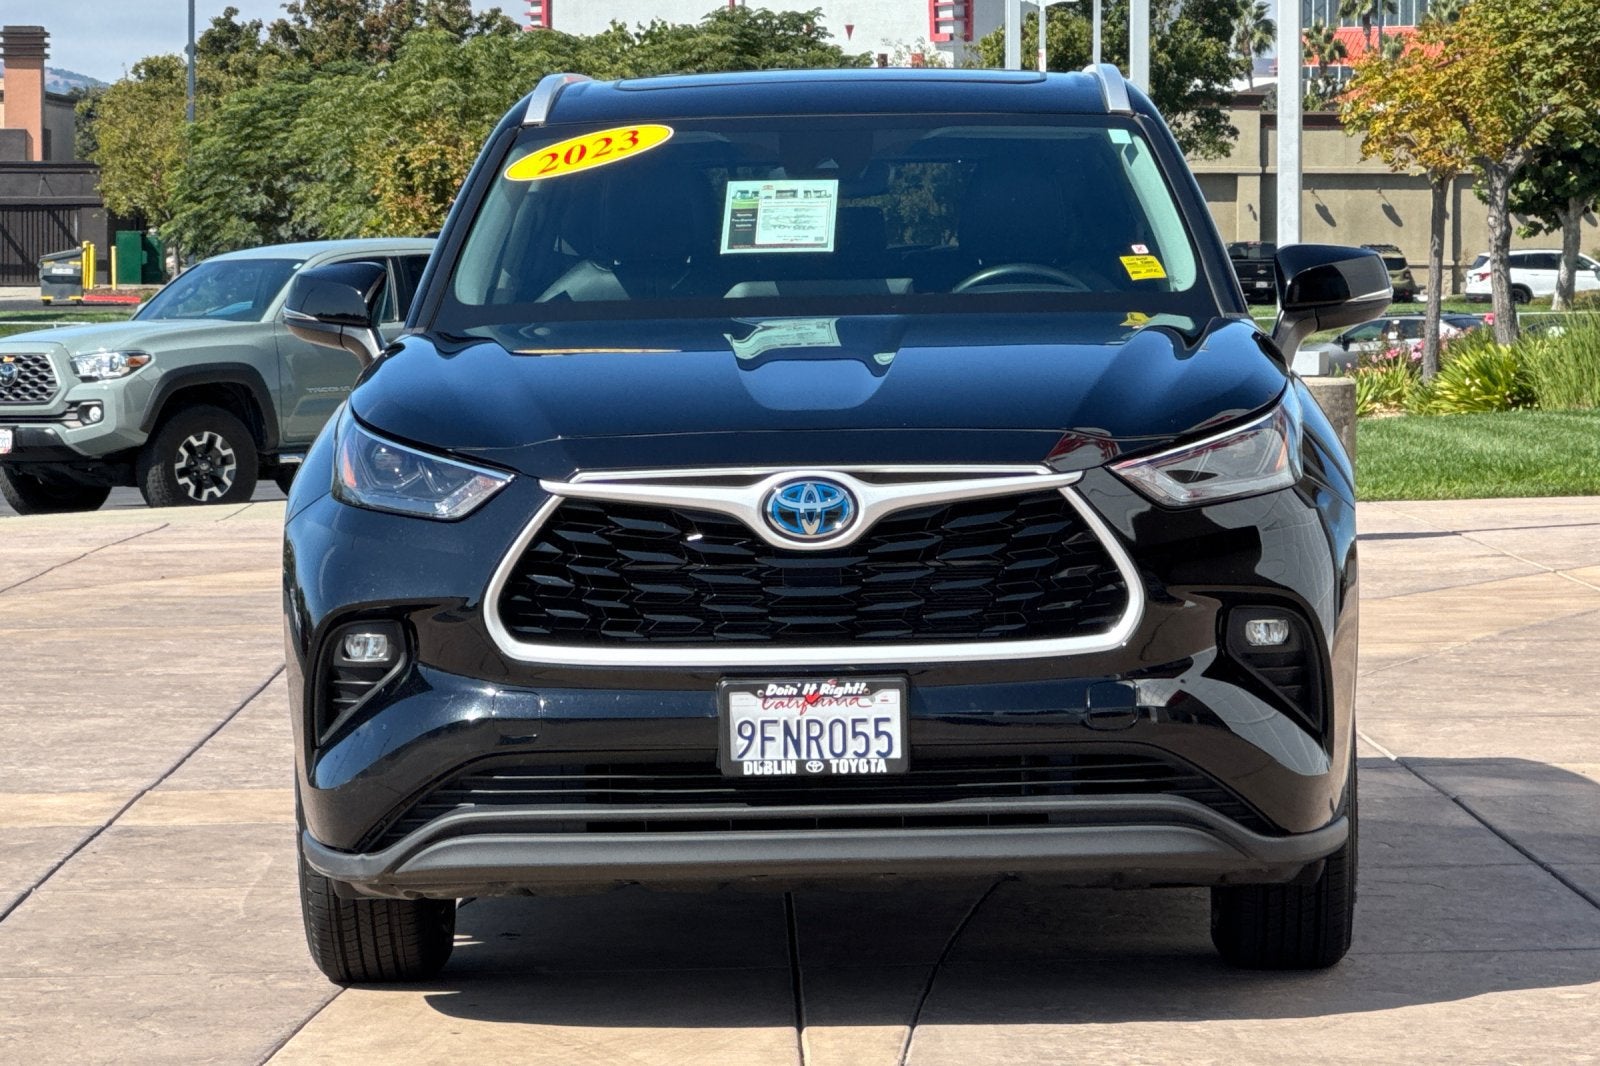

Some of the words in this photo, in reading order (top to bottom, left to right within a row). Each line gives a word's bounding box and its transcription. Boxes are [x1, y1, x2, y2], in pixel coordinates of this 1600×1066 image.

[537, 130, 639, 174] 2023
[765, 683, 801, 696] Doin'
[802, 683, 817, 695] It
[819, 682, 866, 698] Right!
[737, 717, 894, 759] 9FNR055
[743, 760, 797, 775] DUBLIN
[829, 758, 888, 774] TOYOTA
